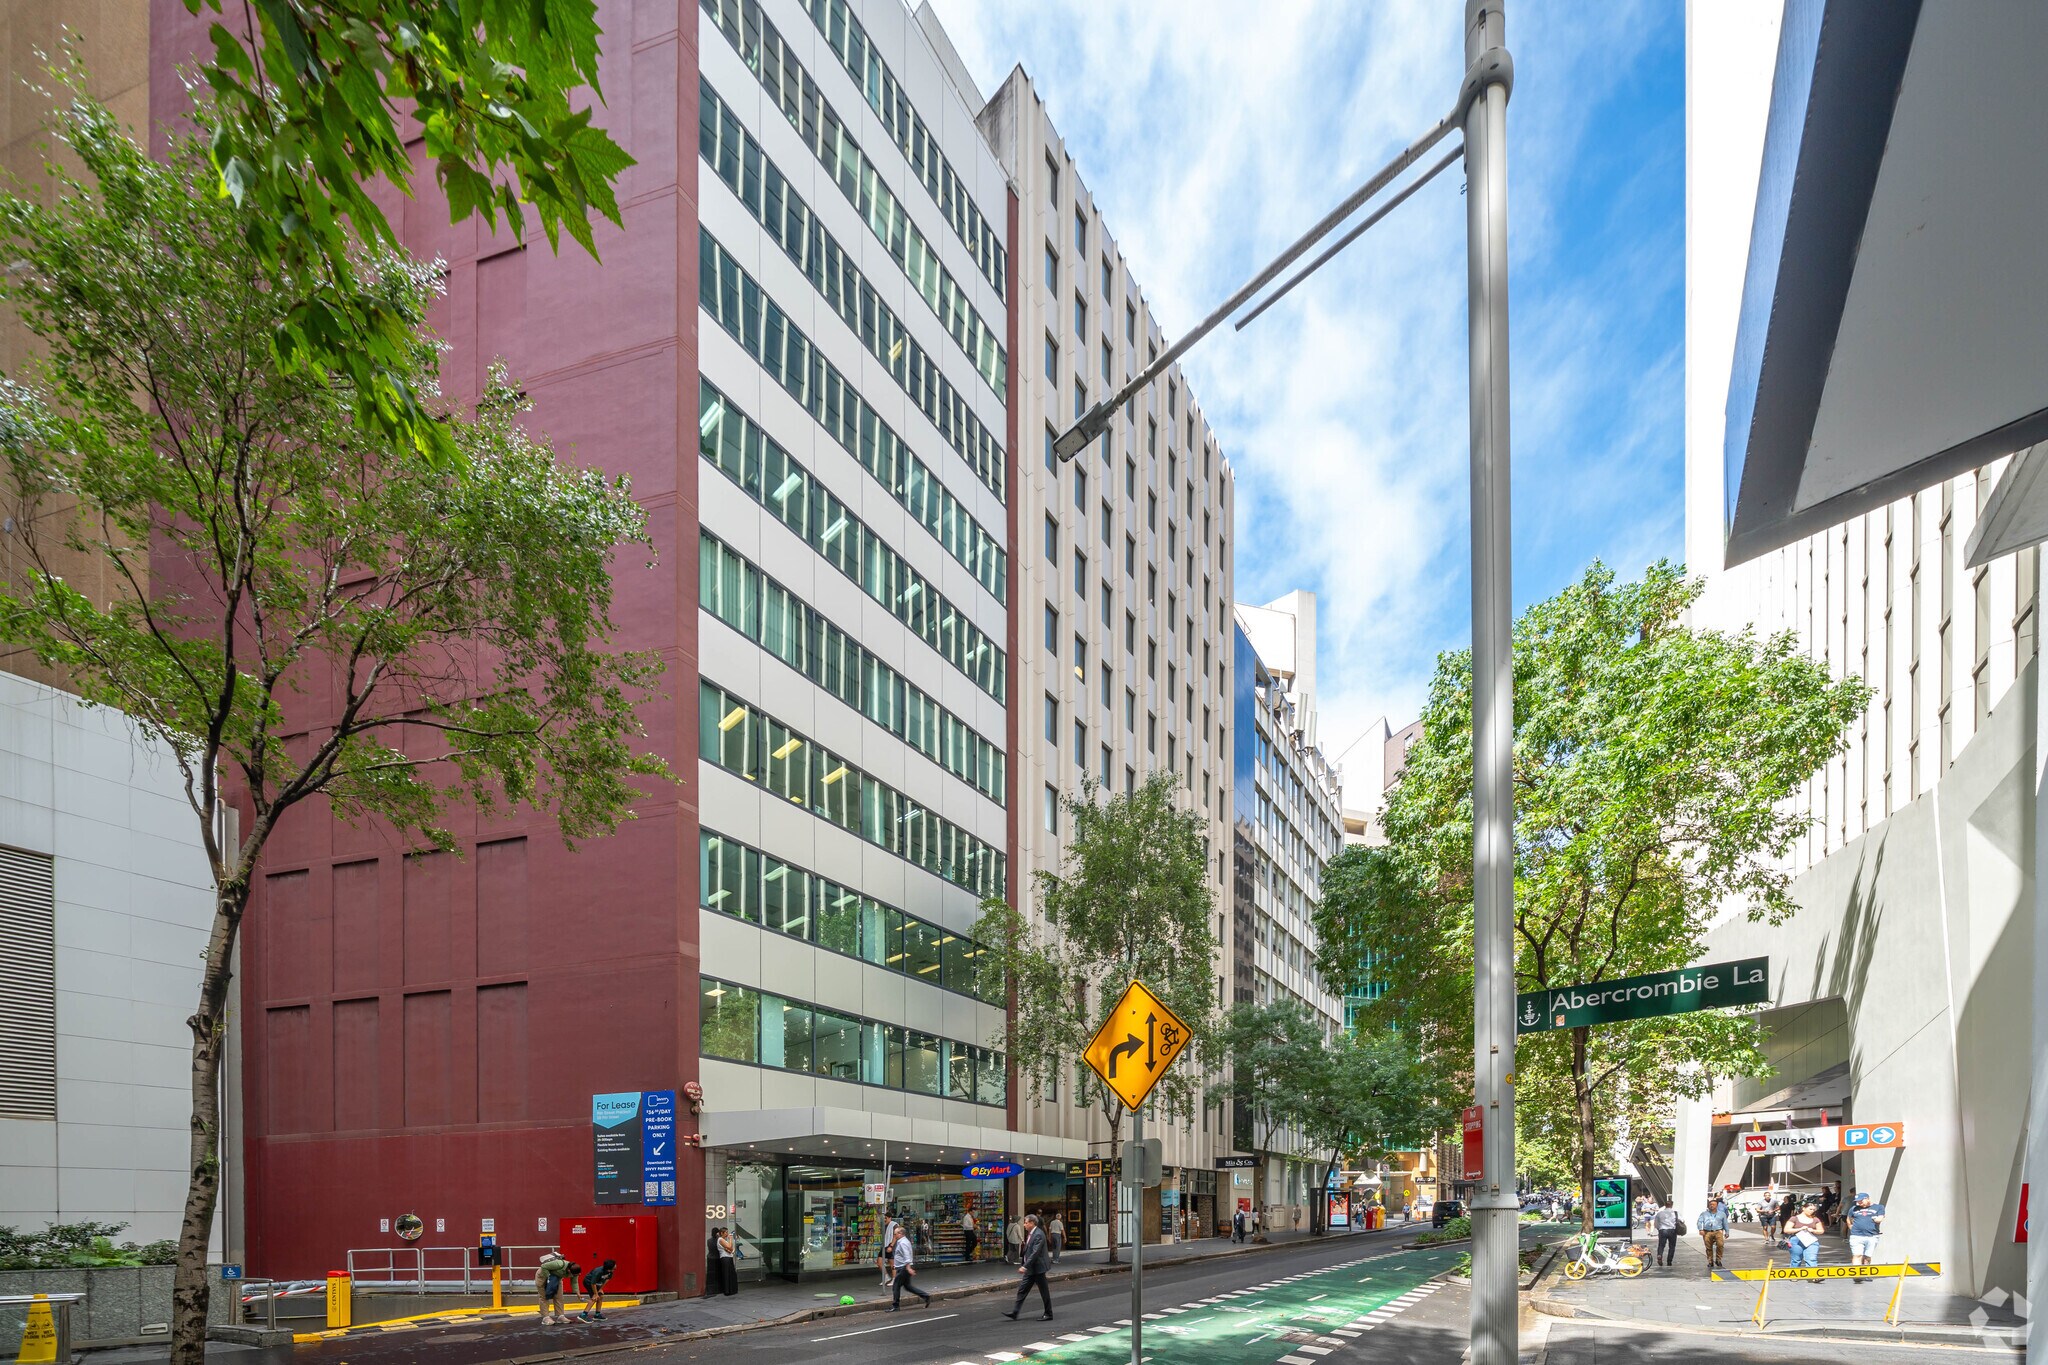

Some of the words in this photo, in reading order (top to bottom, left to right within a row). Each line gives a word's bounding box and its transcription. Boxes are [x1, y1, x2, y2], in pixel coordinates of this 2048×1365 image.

[1552, 972, 1719, 1011] Abercrombie
[1733, 966, 1765, 986] La
[597, 1102, 609, 1110] For
[1465, 1120, 1481, 1131] STOPPING
[1770, 1136, 1815, 1146] Wilson
[1851, 1131, 1864, 1143] P
[979, 1165, 1011, 1177] EzyMart
[705, 1205, 726, 1219] 58
[1770, 1269, 1809, 1279] ROAD
[1816, 1266, 1880, 1277] CLOSED
